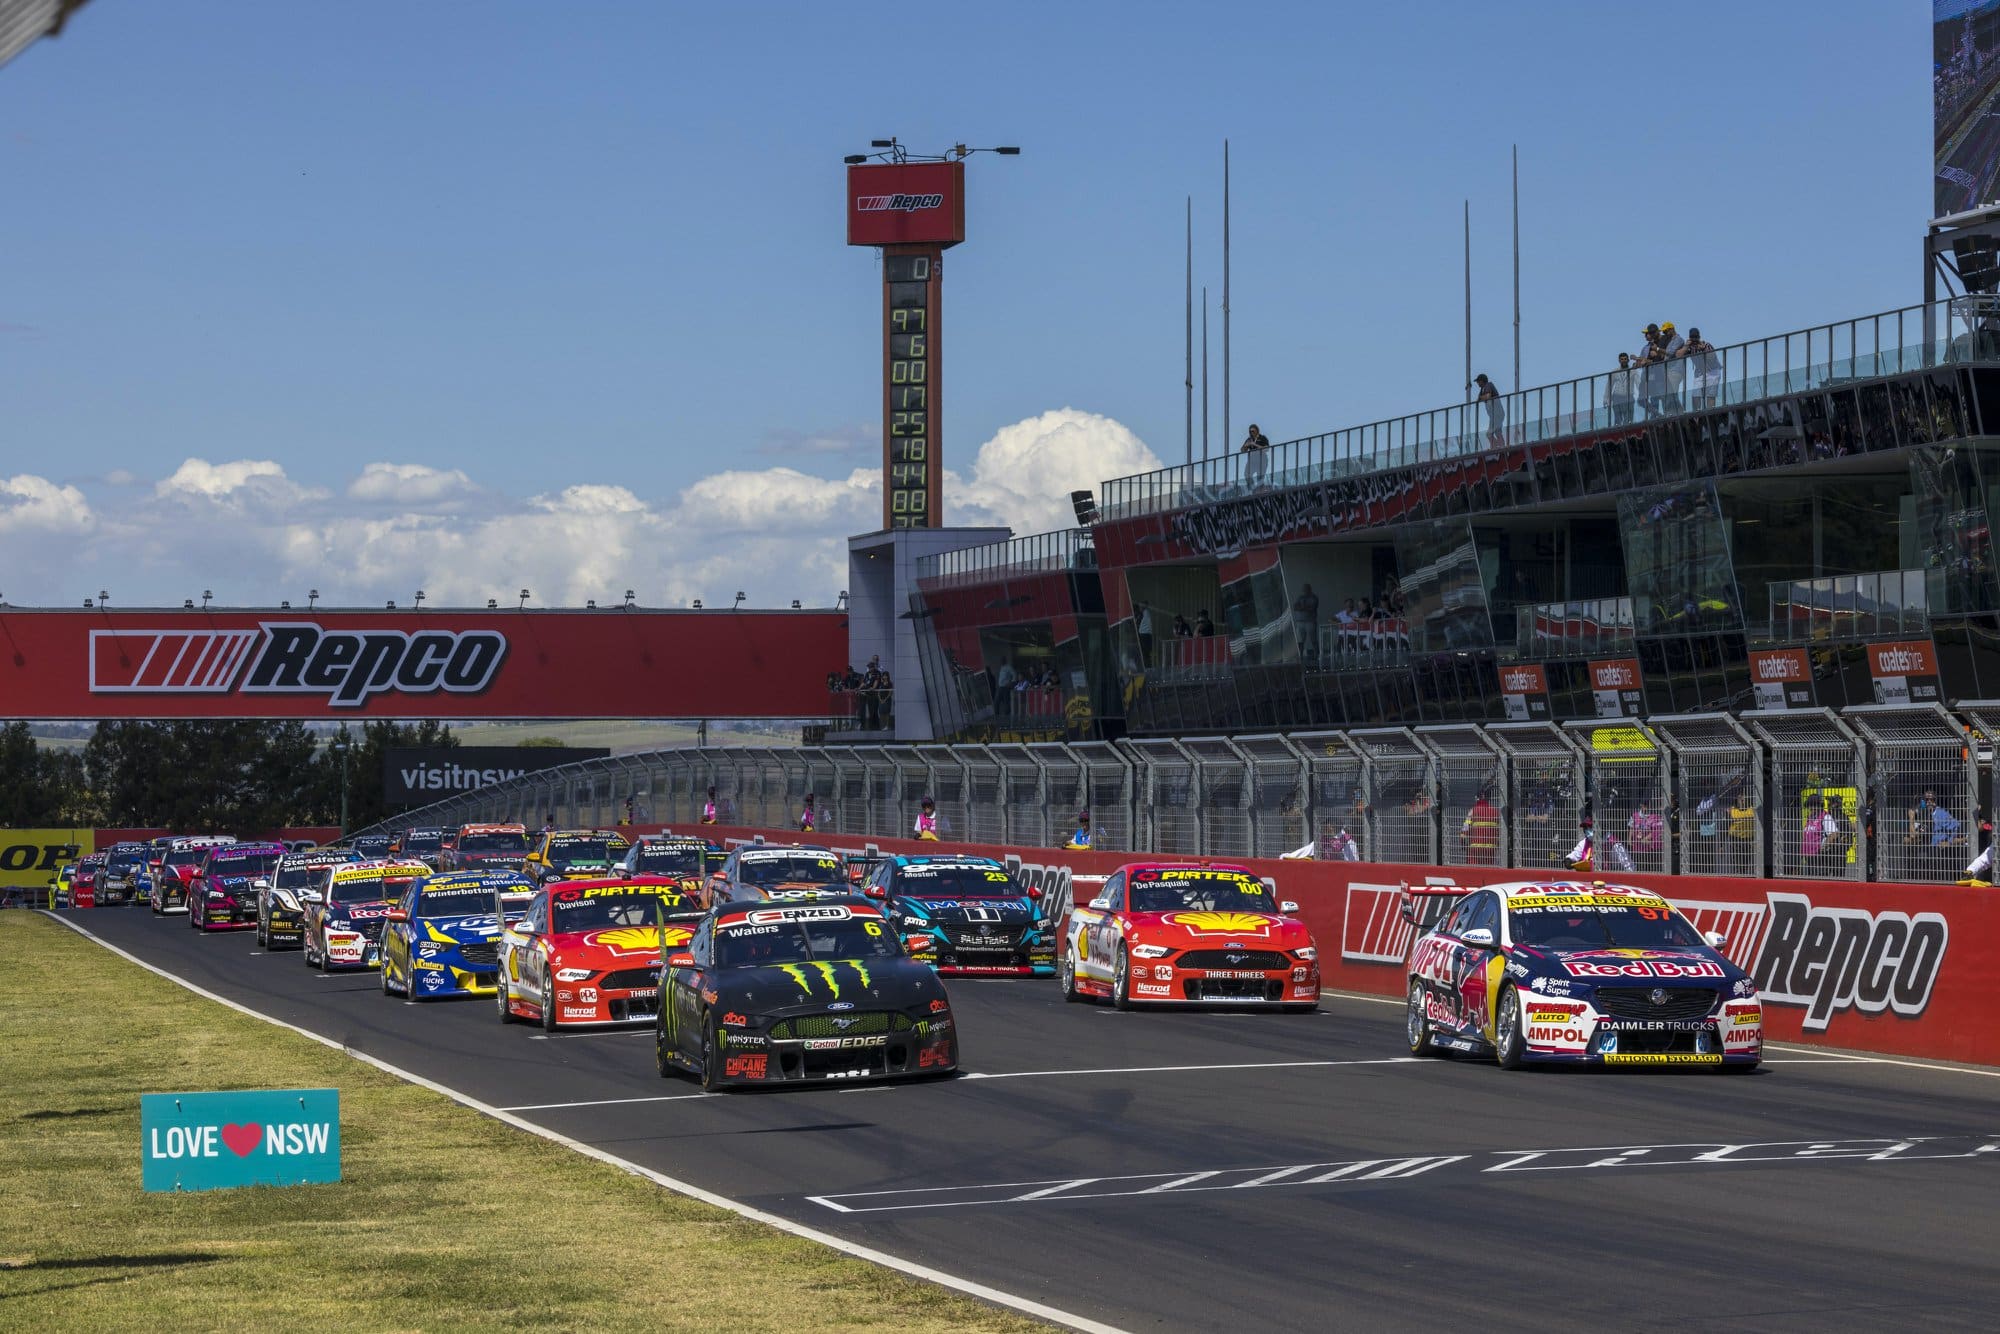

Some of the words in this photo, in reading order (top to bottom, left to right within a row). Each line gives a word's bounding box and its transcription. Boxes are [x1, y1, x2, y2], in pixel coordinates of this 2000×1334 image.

[888, 194, 943, 212] Repco
[893, 309, 925, 331] 97
[910, 335, 925, 357] 6
[892, 361, 926, 383] 00
[903, 386, 925, 408] 17
[893, 413, 925, 435] 25
[903, 438, 926, 460] 18
[893, 464, 926, 485] 44
[240, 622, 506, 706] Repco
[283, 856, 348, 867] Steadfast
[817, 859, 836, 869] 44
[902, 864, 1001, 873] gomo
[335, 870, 381, 880] NATIONAL
[983, 872, 1009, 883] 25
[1161, 871, 1251, 883] PIRTEK
[1149, 880, 1190, 888] Pasquale
[1236, 882, 1263, 895] 100
[583, 886, 674, 899] PIRTEK
[1515, 885, 1655, 897] AMPOL
[558, 898, 596, 911] Davison
[658, 895, 681, 907] 17
[924, 900, 1027, 911] Mobil
[1509, 896, 1590, 906] NATIONAL
[1594, 896, 1670, 908] STORAGE
[782, 909, 842, 919] ENZED
[1515, 907, 1543, 915] van
[1546, 905, 1628, 914] Gisbergen
[1638, 907, 1671, 921] 97
[904, 917, 928, 927] gomo
[728, 925, 779, 938] Waters
[863, 921, 882, 936] 6
[420, 941, 442, 949] SEIKO
[1758, 892, 1949, 1030] Repco
[567, 971, 588, 979] Repco
[1155, 967, 1173, 979] PPG
[1233, 971, 1265, 979] THREES
[422, 977, 445, 985] FUCHS
[1137, 982, 1171, 992] Herrod
[1547, 977, 1570, 987] Spirit
[580, 989, 597, 1001] PPG
[1546, 985, 1571, 996] Super
[563, 1006, 597, 1015] Herrod
[722, 1010, 747, 1024] dba
[1601, 1021, 1664, 1030] DAIMLER
[1666, 1022, 1715, 1031] TRUCKS
[726, 1034, 766, 1045] MONSTER
[1528, 1027, 1588, 1042] AMPOL
[1725, 1029, 1762, 1043] AMPO
[813, 1040, 839, 1049] Castrol
[840, 1035, 889, 1048] EDGE
[725, 1057, 768, 1073] CHICANE
[1606, 1055, 1665, 1063] NATIONAL
[1666, 1055, 1720, 1063] STORAGE
[745, 1071, 766, 1079] TOOLS
[151, 1126, 219, 1159] LOVE
[266, 1123, 330, 1155] NSW
